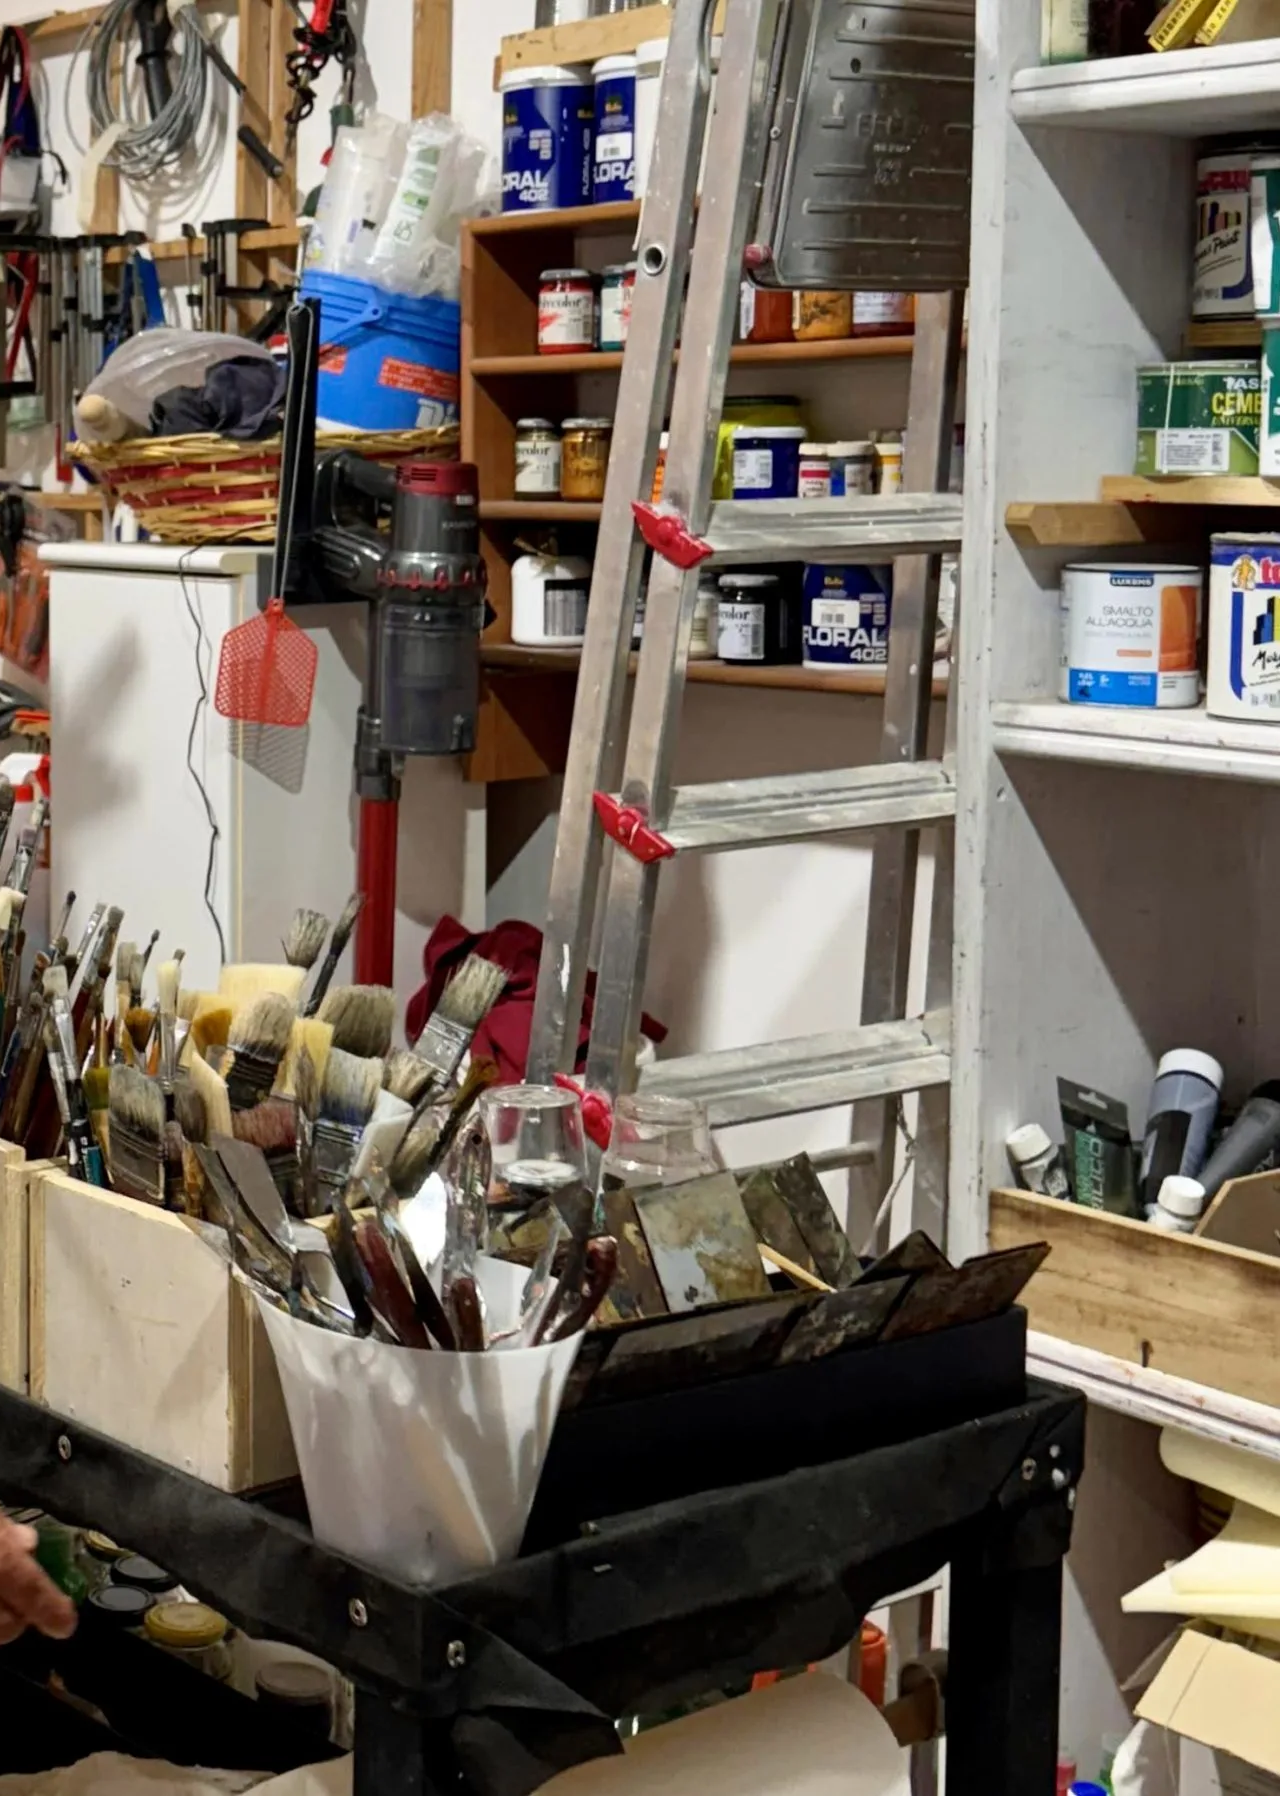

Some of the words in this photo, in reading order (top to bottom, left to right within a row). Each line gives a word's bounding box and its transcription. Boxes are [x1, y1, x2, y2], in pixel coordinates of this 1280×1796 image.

[519, 189, 549, 202] 402
[1111, 578, 1152, 586] LUXENS
[1102, 605, 1154, 617] SMALTO
[850, 648, 888, 662] 402
